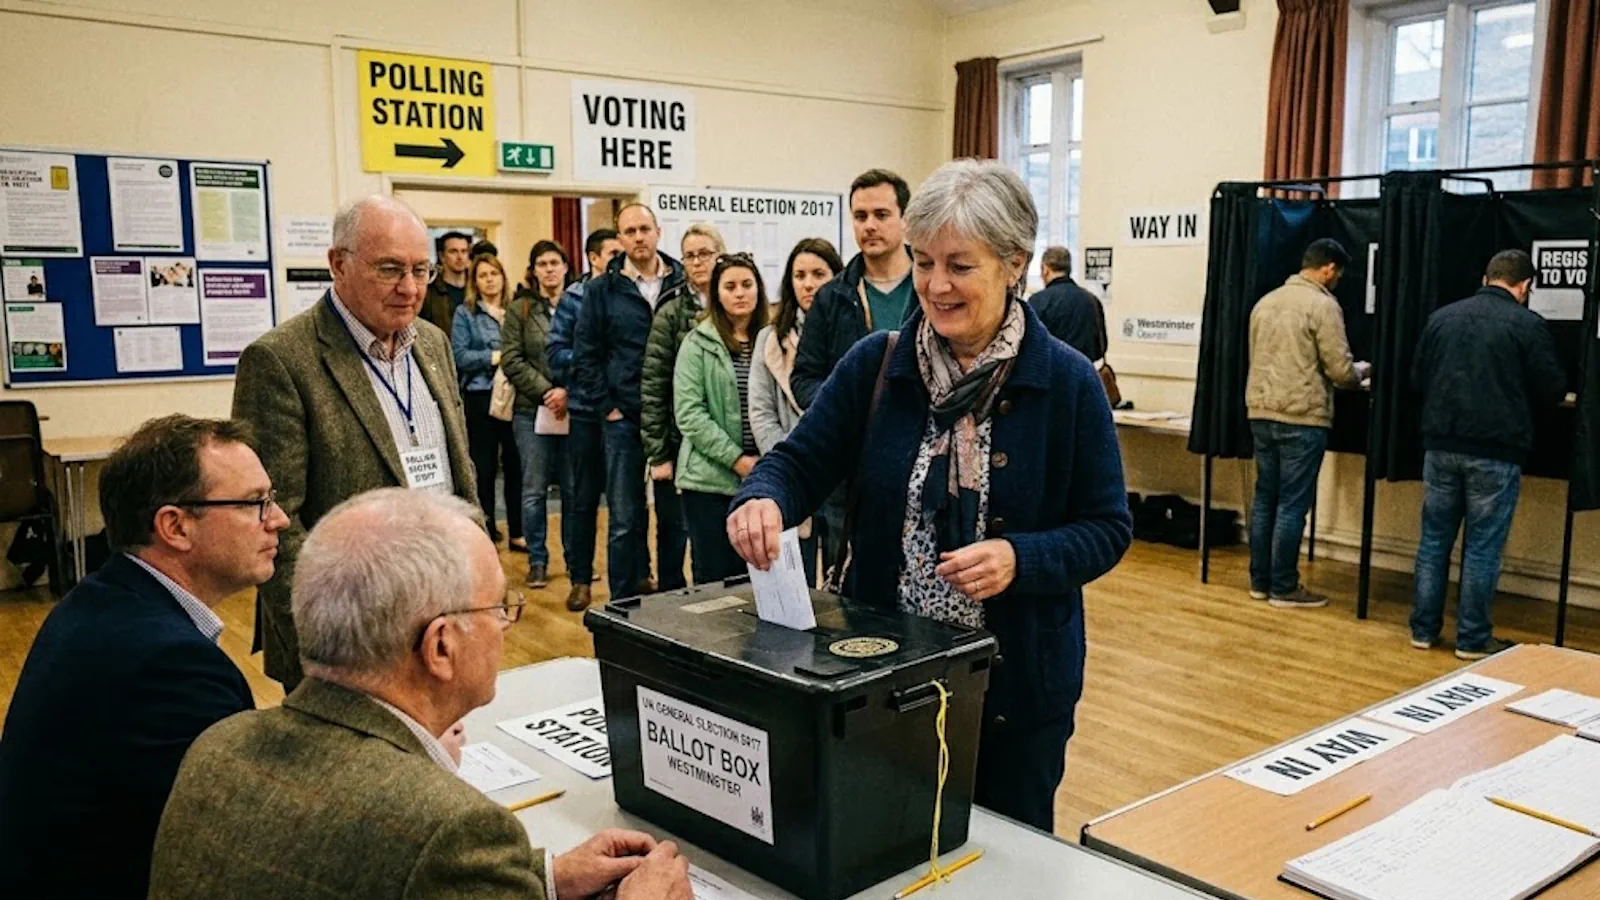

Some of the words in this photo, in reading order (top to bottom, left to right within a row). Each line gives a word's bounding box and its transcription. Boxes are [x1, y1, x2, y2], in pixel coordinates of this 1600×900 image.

[369, 61, 484, 97] POLLING
[372, 98, 484, 131] STATION
[583, 94, 686, 132] VOTING
[601, 137, 673, 169] HERE
[658, 193, 726, 213] GENERAL
[730, 197, 796, 215] ELECTION
[801, 200, 834, 216] 2017
[1129, 215, 1171, 239] WAY
[1177, 213, 1197, 238] IN
[1541, 250, 1588, 268] REGIS
[1541, 268, 1561, 285] TO
[1565, 268, 1587, 286] VO
[1137, 318, 1195, 331] Westminster
[1426, 682, 1497, 712] WAY
[1393, 703, 1445, 723] IN
[647, 718, 715, 766] BALLOT
[720, 748, 761, 787] BOX
[1304, 729, 1389, 764] WAY
[667, 755, 741, 797] WESTMINSTER
[1264, 756, 1321, 780] IN
